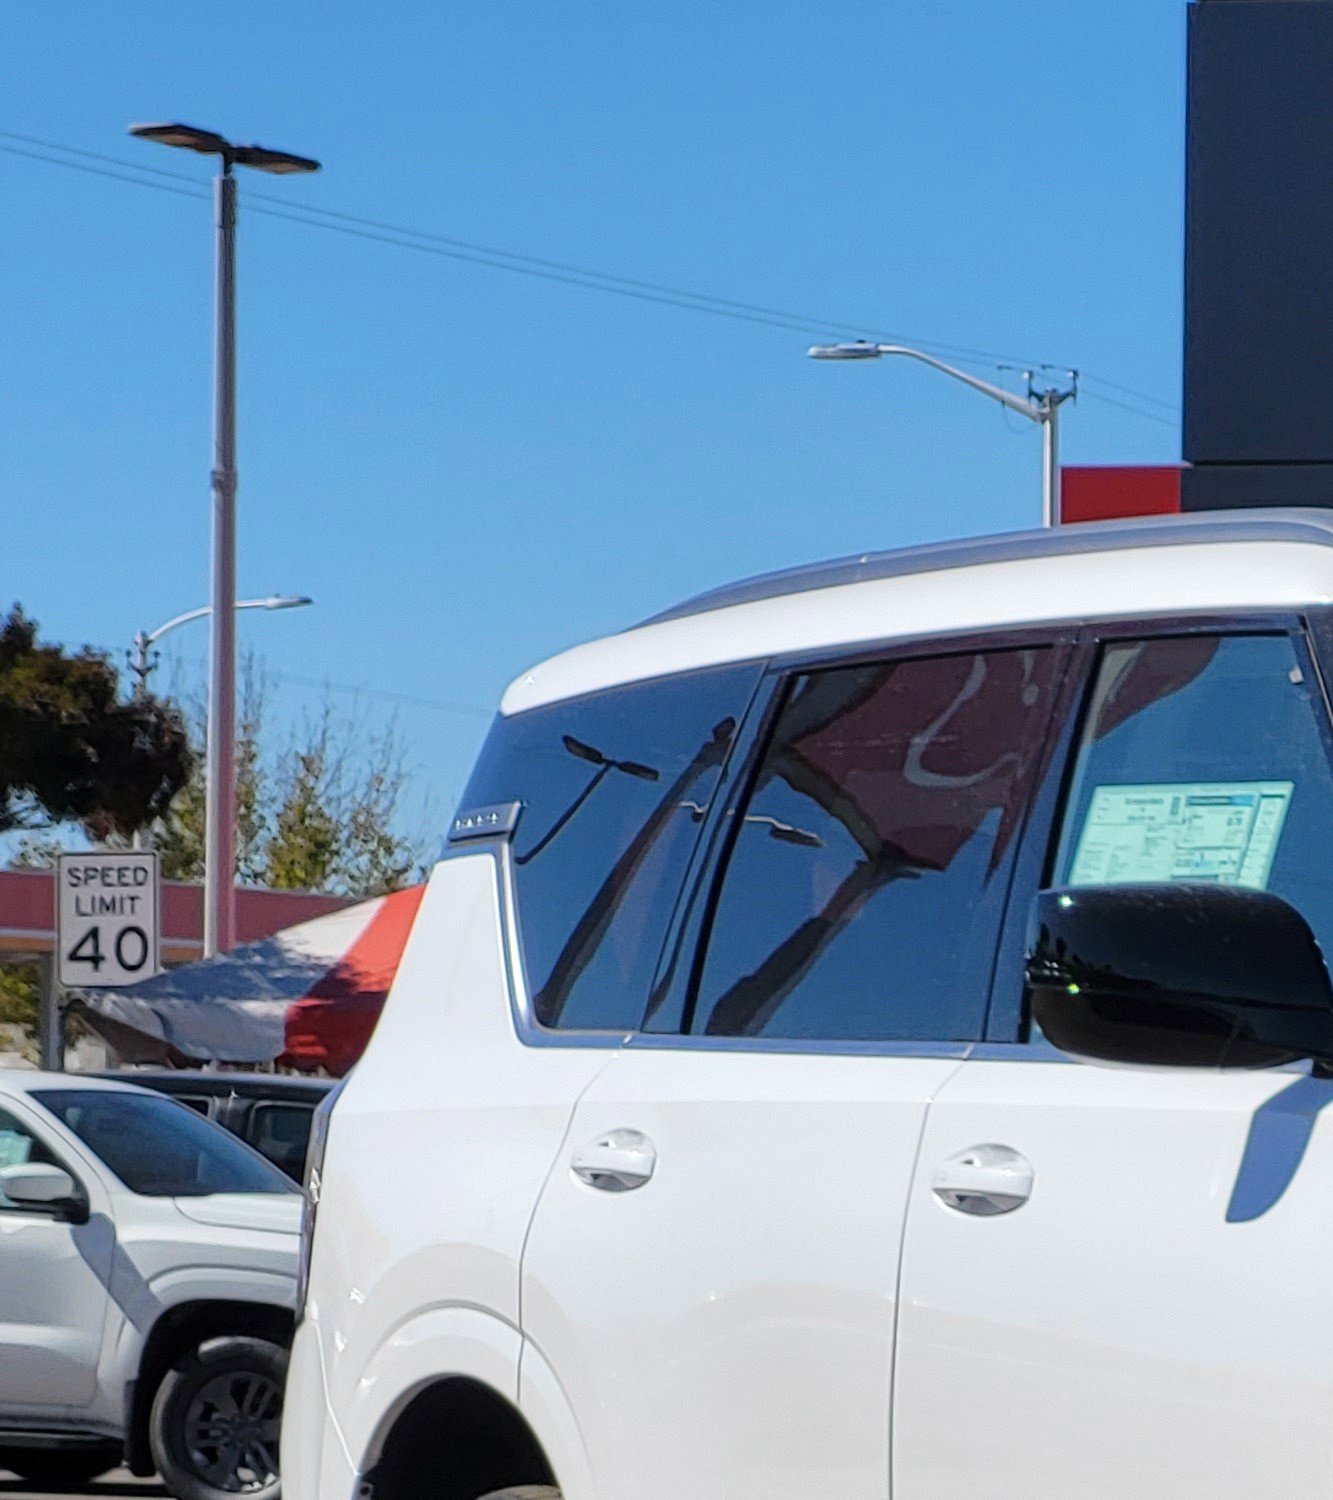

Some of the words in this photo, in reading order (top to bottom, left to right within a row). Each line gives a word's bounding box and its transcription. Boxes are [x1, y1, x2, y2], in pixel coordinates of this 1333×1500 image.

[68, 867, 149, 888] SPEED
[75, 894, 142, 917] LIMIT
[68, 925, 149, 972] 40
